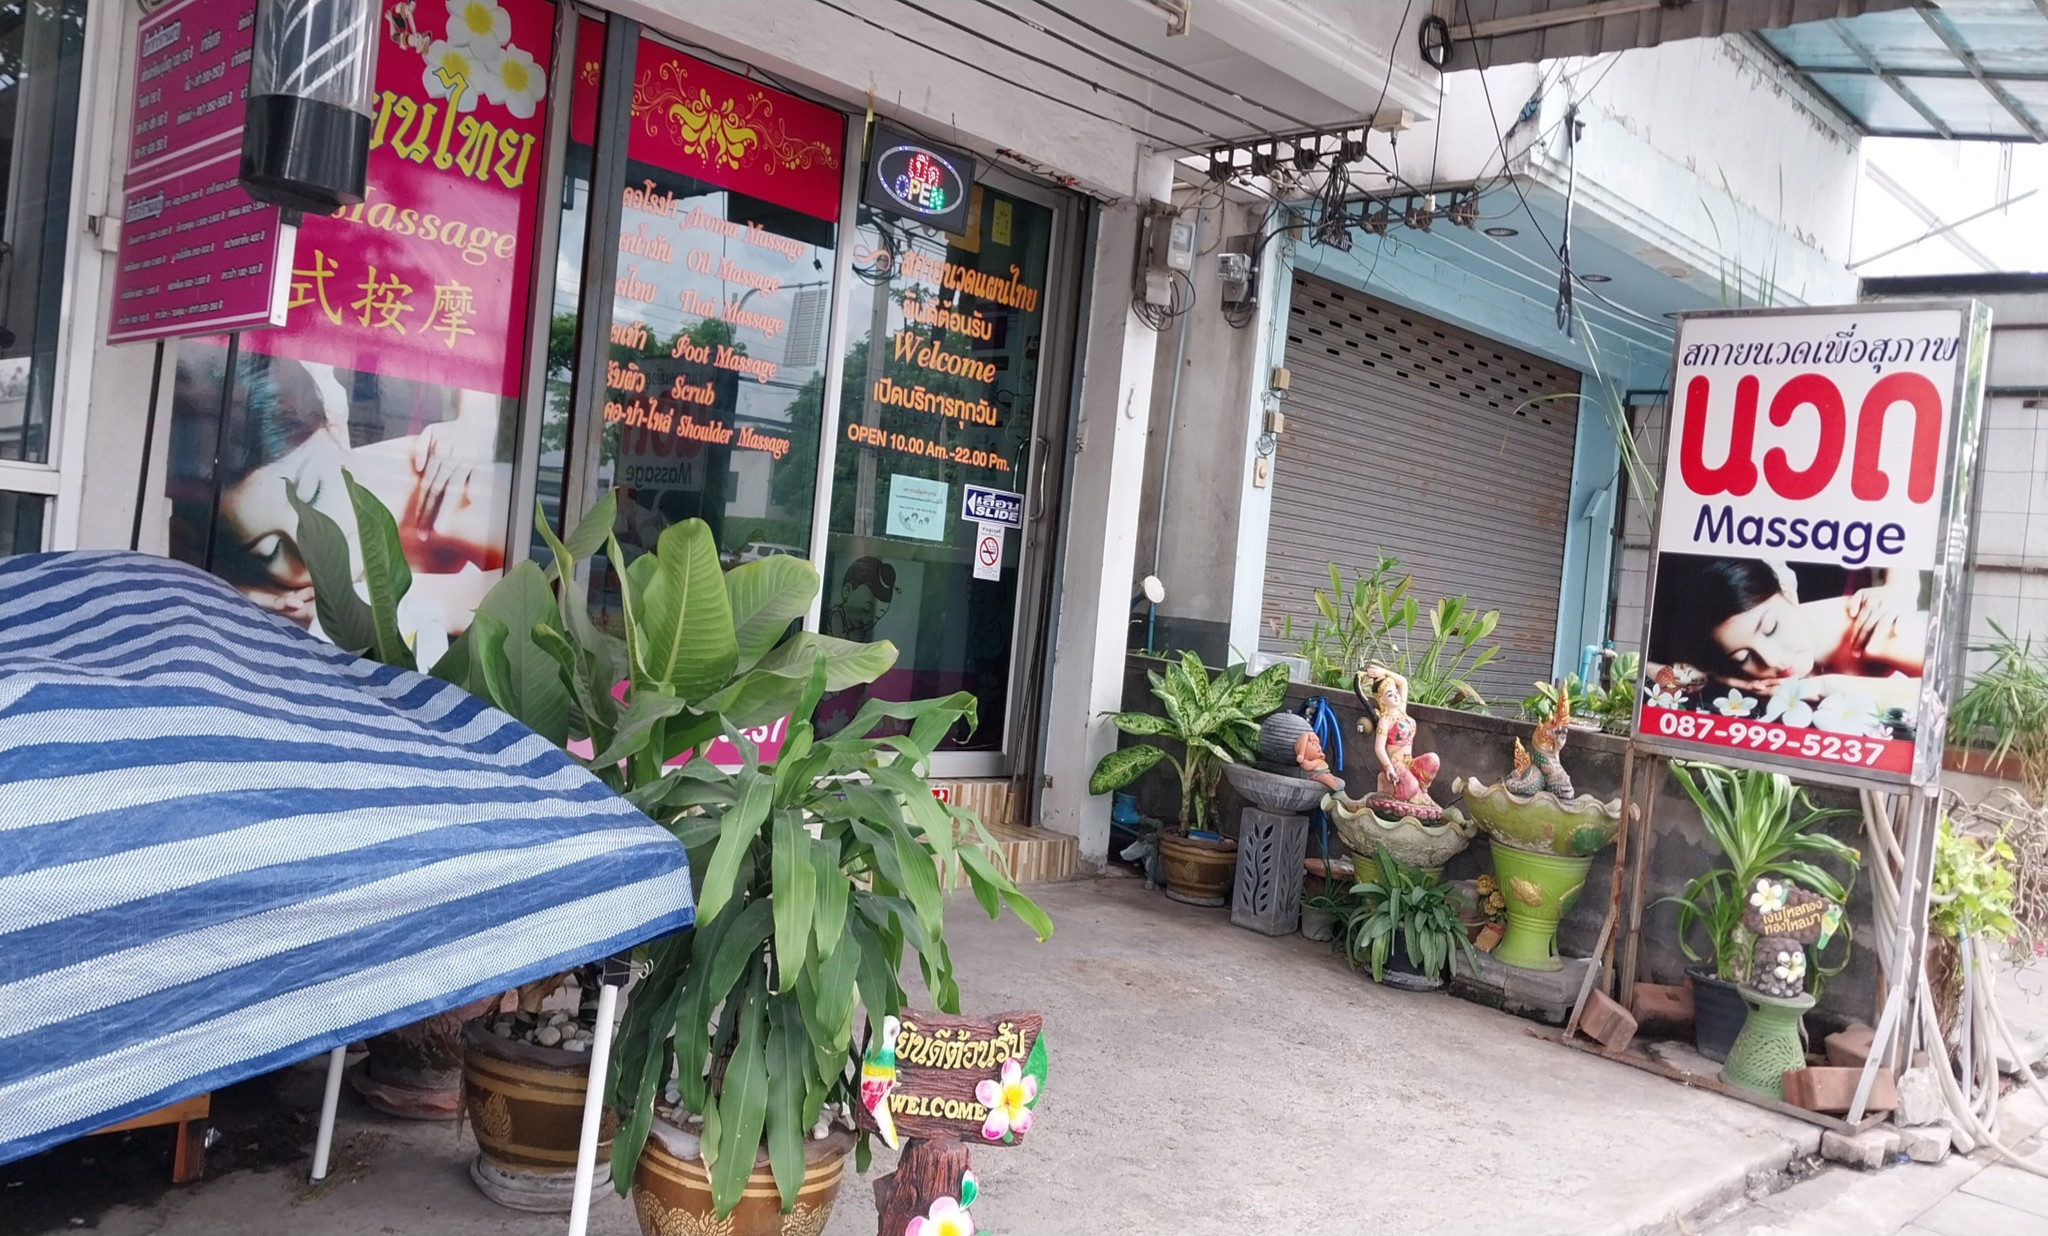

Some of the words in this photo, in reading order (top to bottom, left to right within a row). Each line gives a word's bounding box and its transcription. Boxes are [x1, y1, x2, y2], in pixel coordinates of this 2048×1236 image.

[894, 174, 945, 211] OPEN
[680, 204, 739, 239] Aroma
[744, 220, 807, 263] Massage
[687, 248, 712, 275] Oil
[716, 257, 781, 298] Massage
[680, 289, 717, 319] Thai
[720, 299, 783, 338] Massage
[903, 290, 993, 341] ยินดีต้อนรับ
[671, 333, 710, 365] Foot
[713, 344, 778, 383] Massage
[893, 329, 996, 384] Welcome
[1683, 323, 1959, 374] สกายนวดเพื่อสุภาพ
[671, 374, 715, 406] Scrub
[873, 377, 997, 430] เปิดบริการทุกวัน
[676, 414, 733, 444] Shoulder
[736, 425, 790, 460] Massage
[847, 423, 887, 447] OPEN
[890, 432, 924, 455] 10.00
[989, 452, 1010, 472] Pm.
[1680, 371, 1943, 504] นวด
[975, 506, 1018, 522] SLIDE
[976, 493, 1019, 511] เลื่อน
[1692, 503, 1906, 565] Massage
[1659, 711, 1885, 767] 087-999-5237
[895, 1021, 1026, 1070] ยินดีต้อนรับ
[888, 1094, 988, 1122] WELCOME
